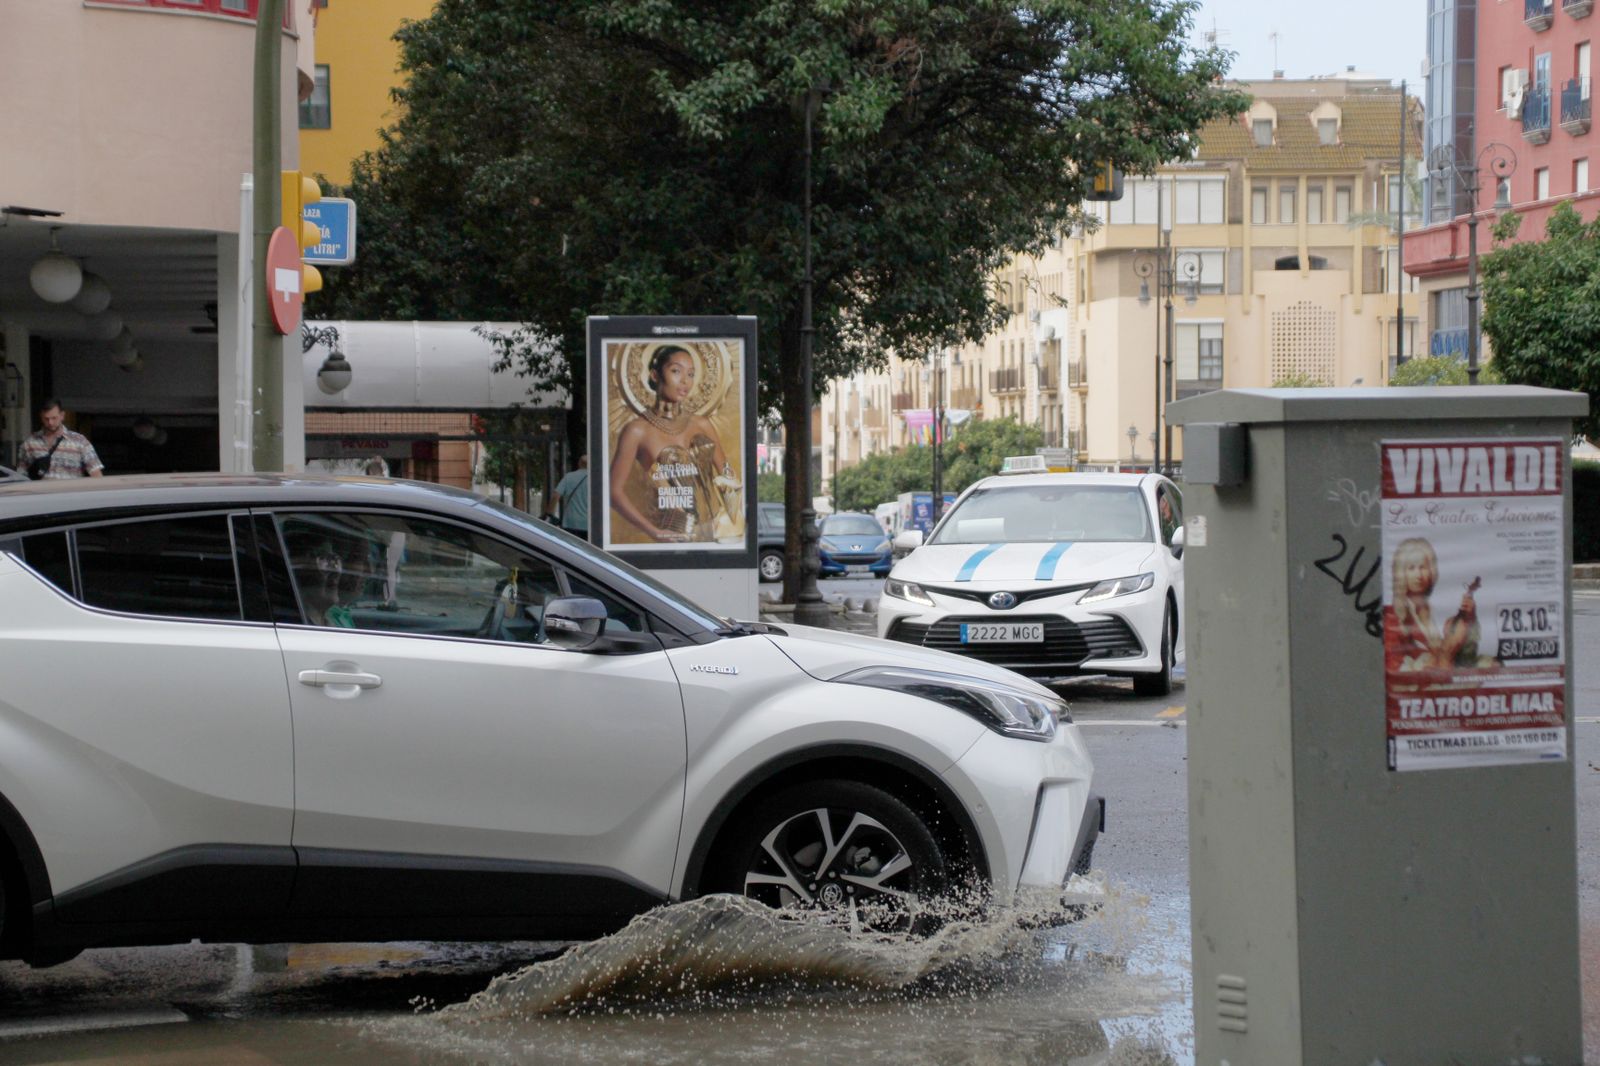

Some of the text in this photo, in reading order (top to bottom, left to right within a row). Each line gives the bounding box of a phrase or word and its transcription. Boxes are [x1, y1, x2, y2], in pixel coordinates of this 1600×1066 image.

[303, 208, 321, 218] LAZA
[1387, 446, 1557, 494] VIVALDI
[658, 486, 693, 496] GAULTIER
[658, 496, 693, 508] DIVINE
[971, 626, 1040, 640] 2222 MGC
[690, 664, 732, 674] HYBRID
[1398, 692, 1555, 719] TEATRO DEL MAR
[1407, 735, 1500, 750] TICKETMASTER.ES
